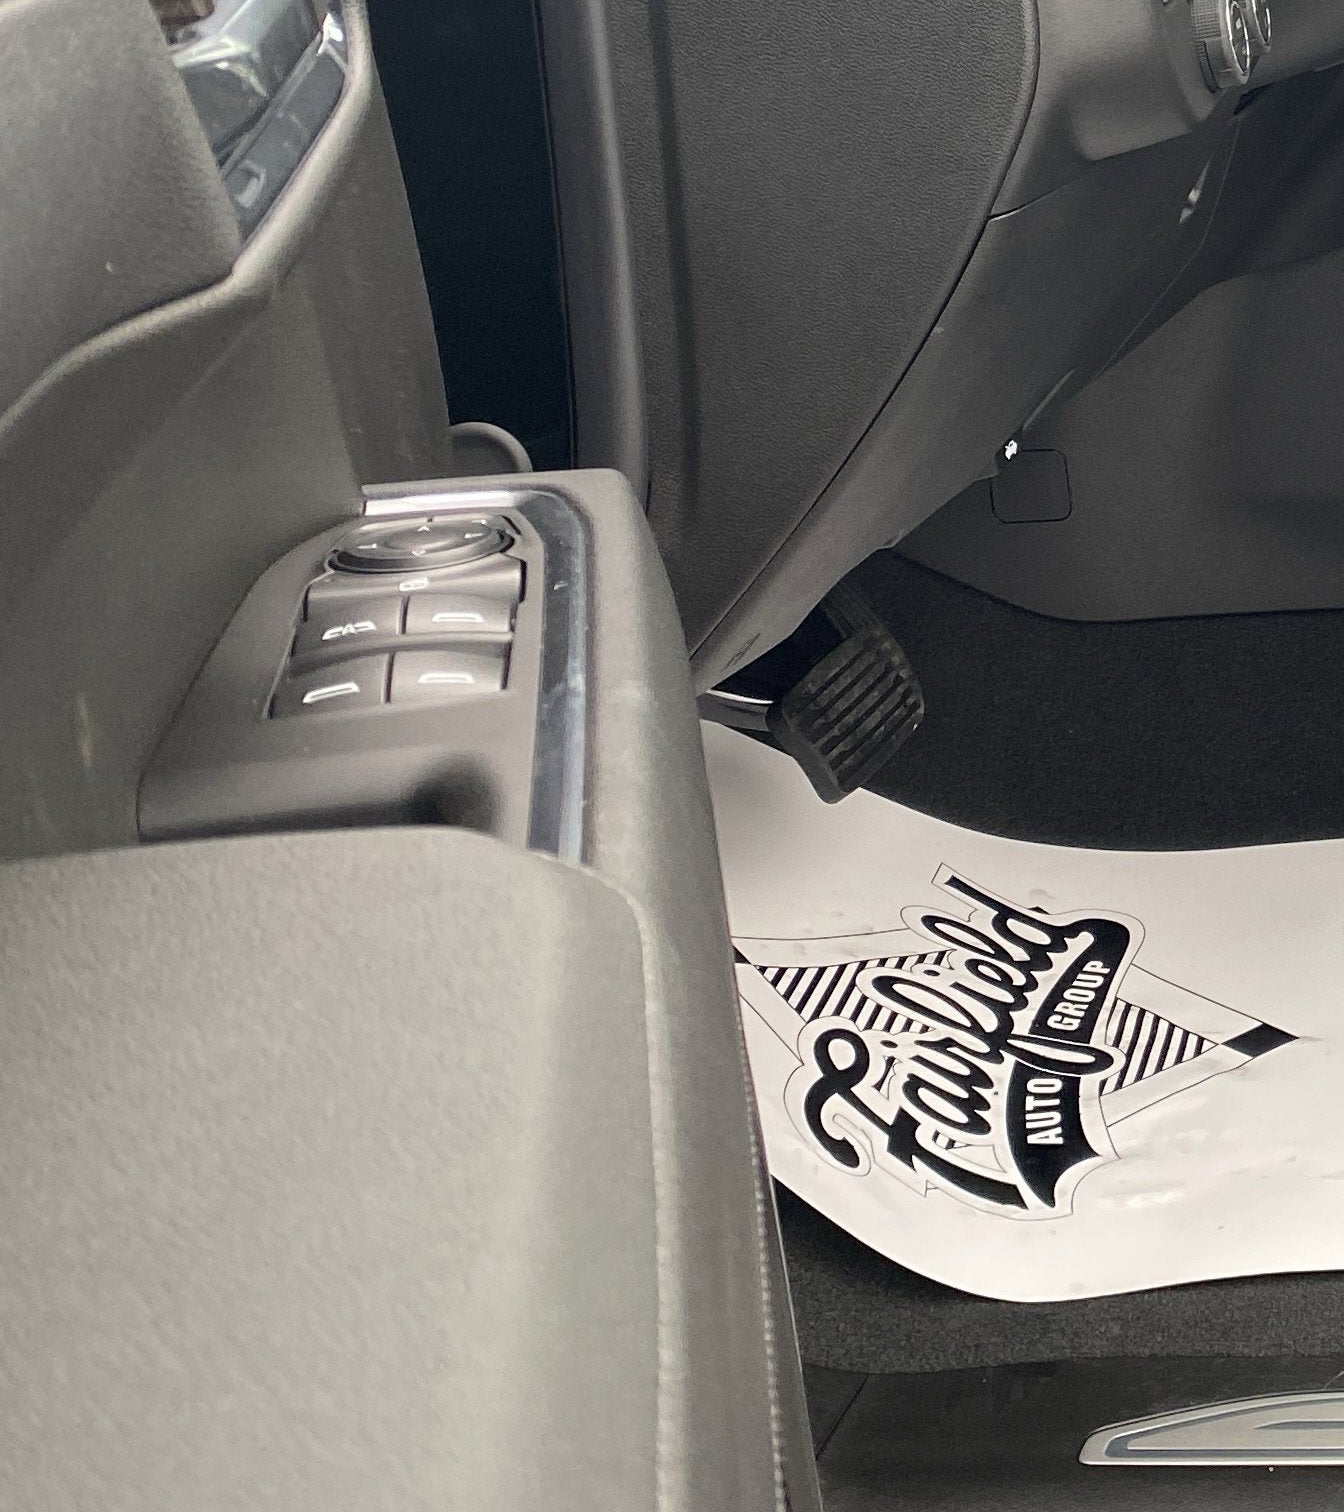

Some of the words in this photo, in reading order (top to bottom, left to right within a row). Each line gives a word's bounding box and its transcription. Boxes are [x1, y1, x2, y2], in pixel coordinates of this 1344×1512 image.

[804, 875, 1114, 1209] Fairfield
[1025, 1077, 1064, 1145] AUTO
[1046, 960, 1112, 1032] GROUP
